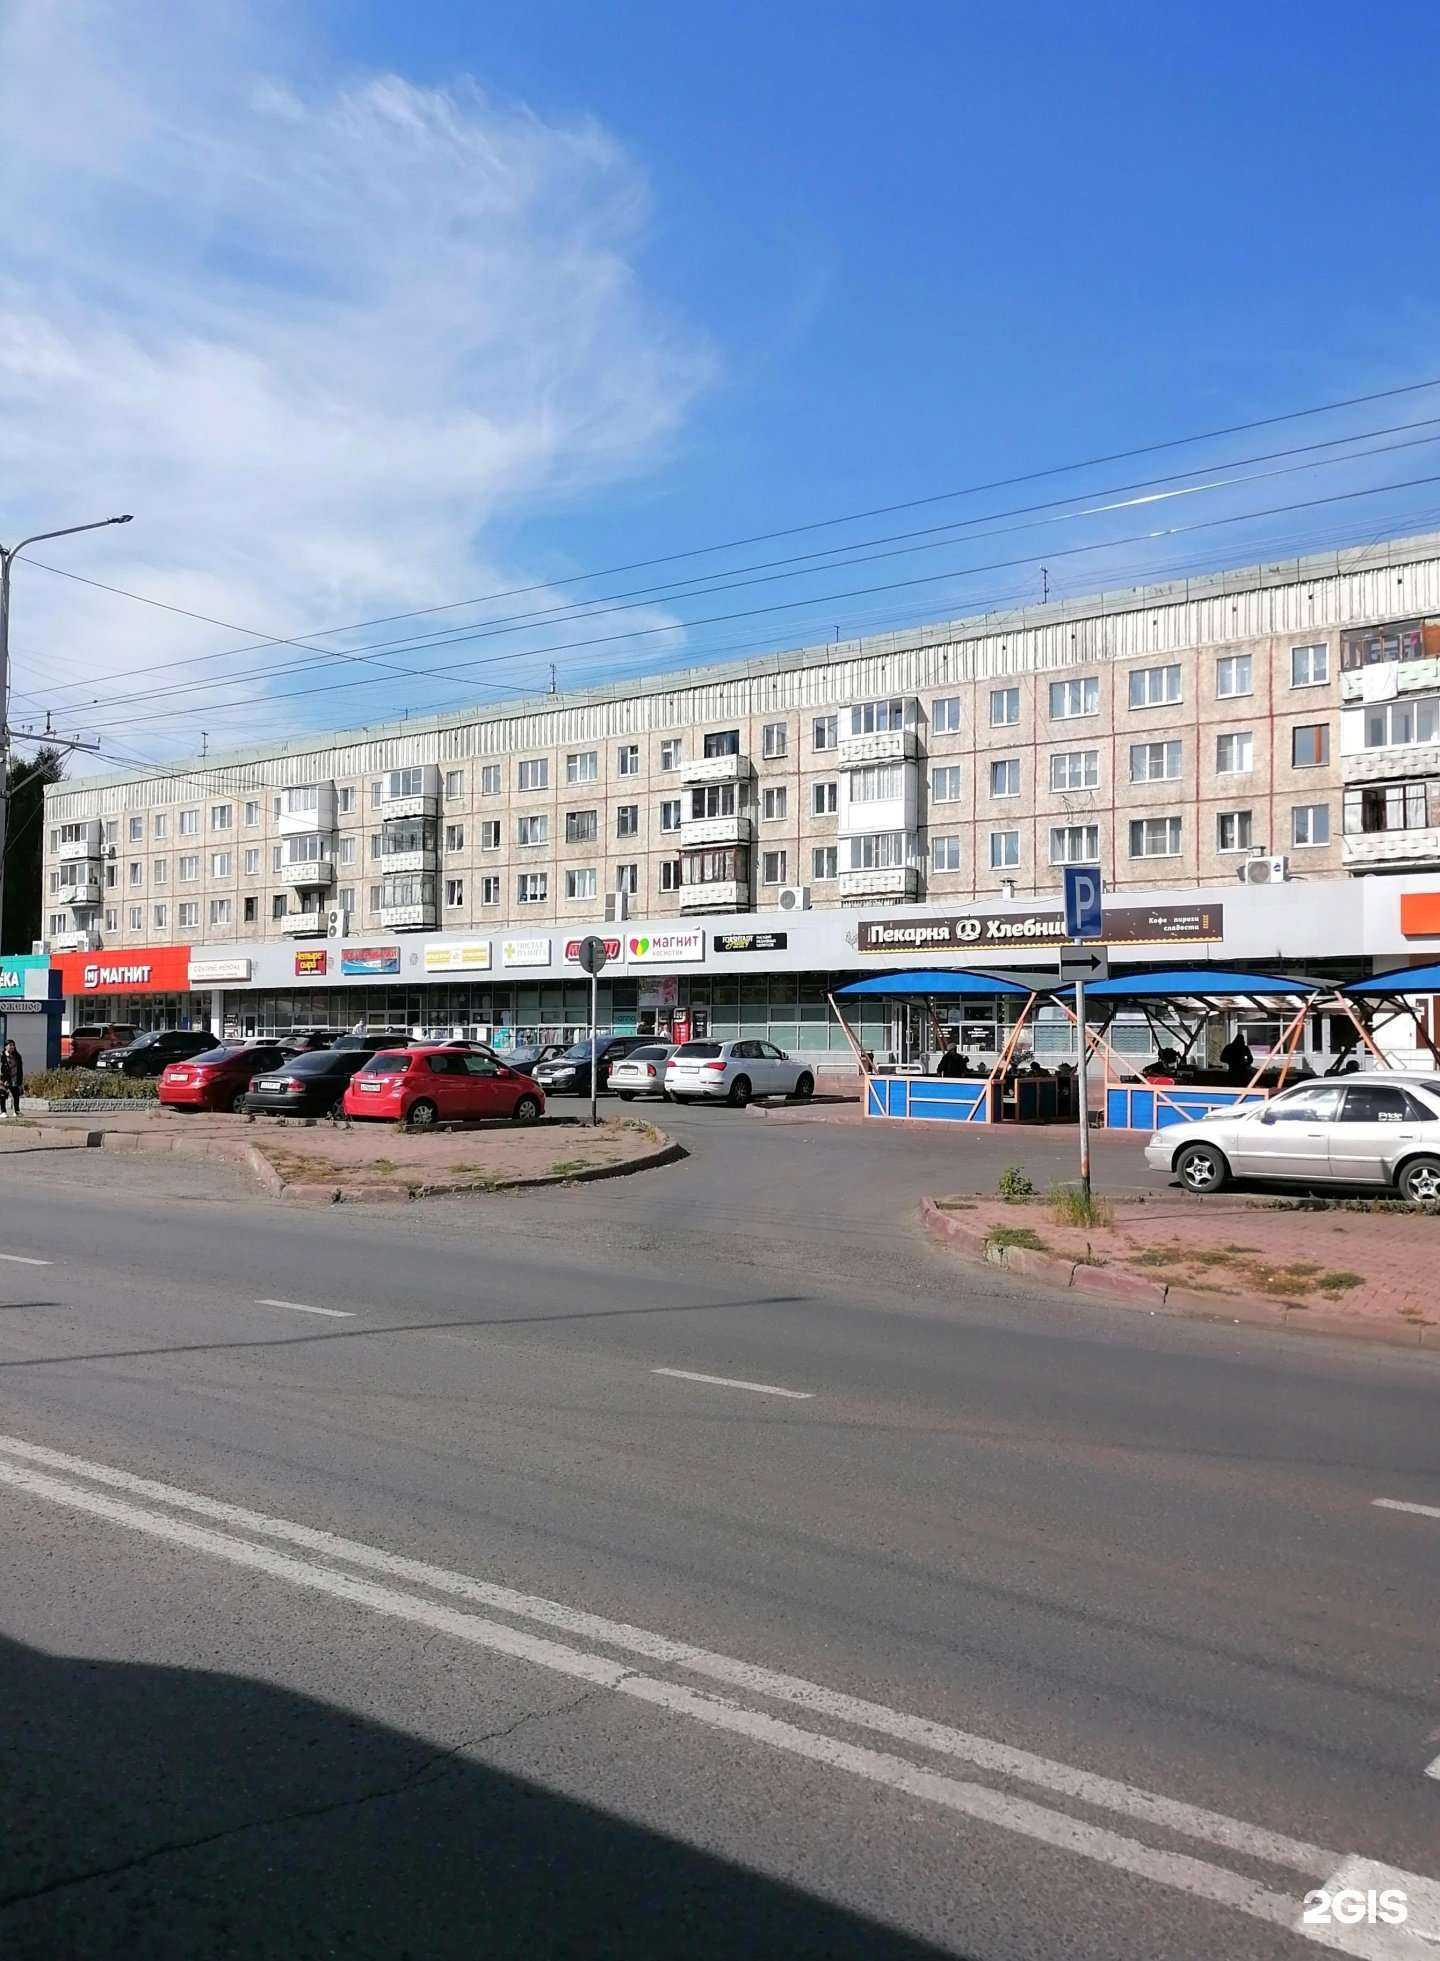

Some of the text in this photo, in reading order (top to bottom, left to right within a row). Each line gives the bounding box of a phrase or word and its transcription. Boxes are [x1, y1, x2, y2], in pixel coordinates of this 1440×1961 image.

[1075, 875, 1095, 930] P
[1148, 916, 1199, 925] Кофе пироги
[1164, 924, 1199, 932] сладости
[870, 918, 1066, 946] Пекарня Хлебни
[99, 965, 152, 984] МАГНИТ
